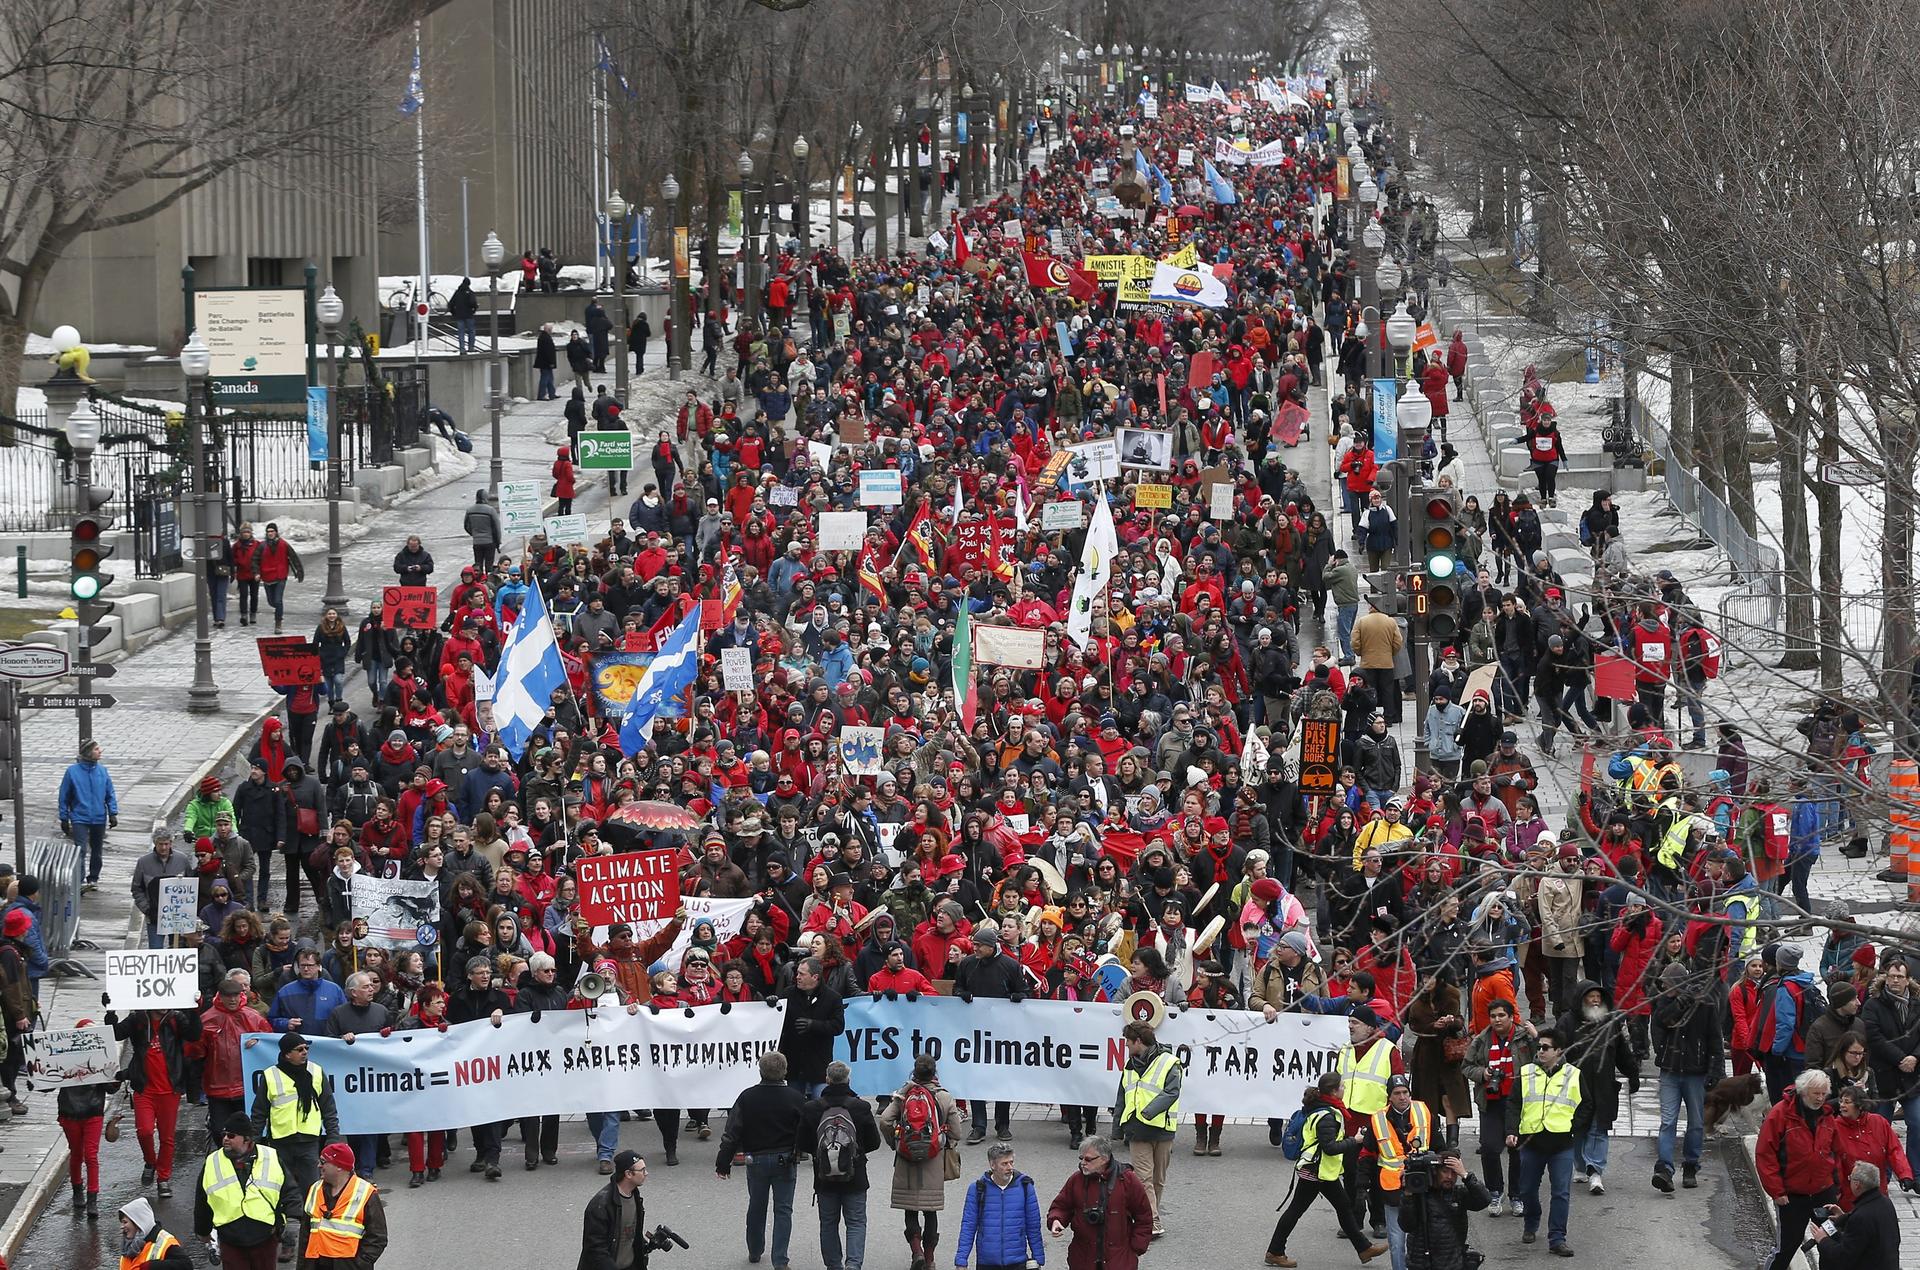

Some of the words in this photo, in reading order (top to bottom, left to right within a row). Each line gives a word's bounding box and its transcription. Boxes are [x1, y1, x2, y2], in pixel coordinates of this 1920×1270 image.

[1091, 260, 1126, 270] AMNISTIE
[211, 381, 259, 394] Canada
[43, 697, 62, 706] Centre
[65, 697, 75, 706] des
[78, 697, 101, 708] congrès
[1305, 731, 1326, 744] PAS
[1304, 744, 1325, 753] CHEZ
[1304, 753, 1324, 762] NOUS
[580, 854, 671, 882] CLIMATE
[165, 886, 194, 894] FOSSIL
[590, 879, 664, 904] ACTION
[162, 905, 181, 913] OUT
[845, 1027, 899, 1062] YES
[911, 1029, 942, 1062] to
[954, 1030, 1072, 1068] climate
[1206, 1046, 1258, 1080] TAR
[344, 1067, 424, 1093] climat
[454, 1055, 501, 1087] NON
[508, 1049, 552, 1077] AUX
[564, 1043, 640, 1074] SABLES
